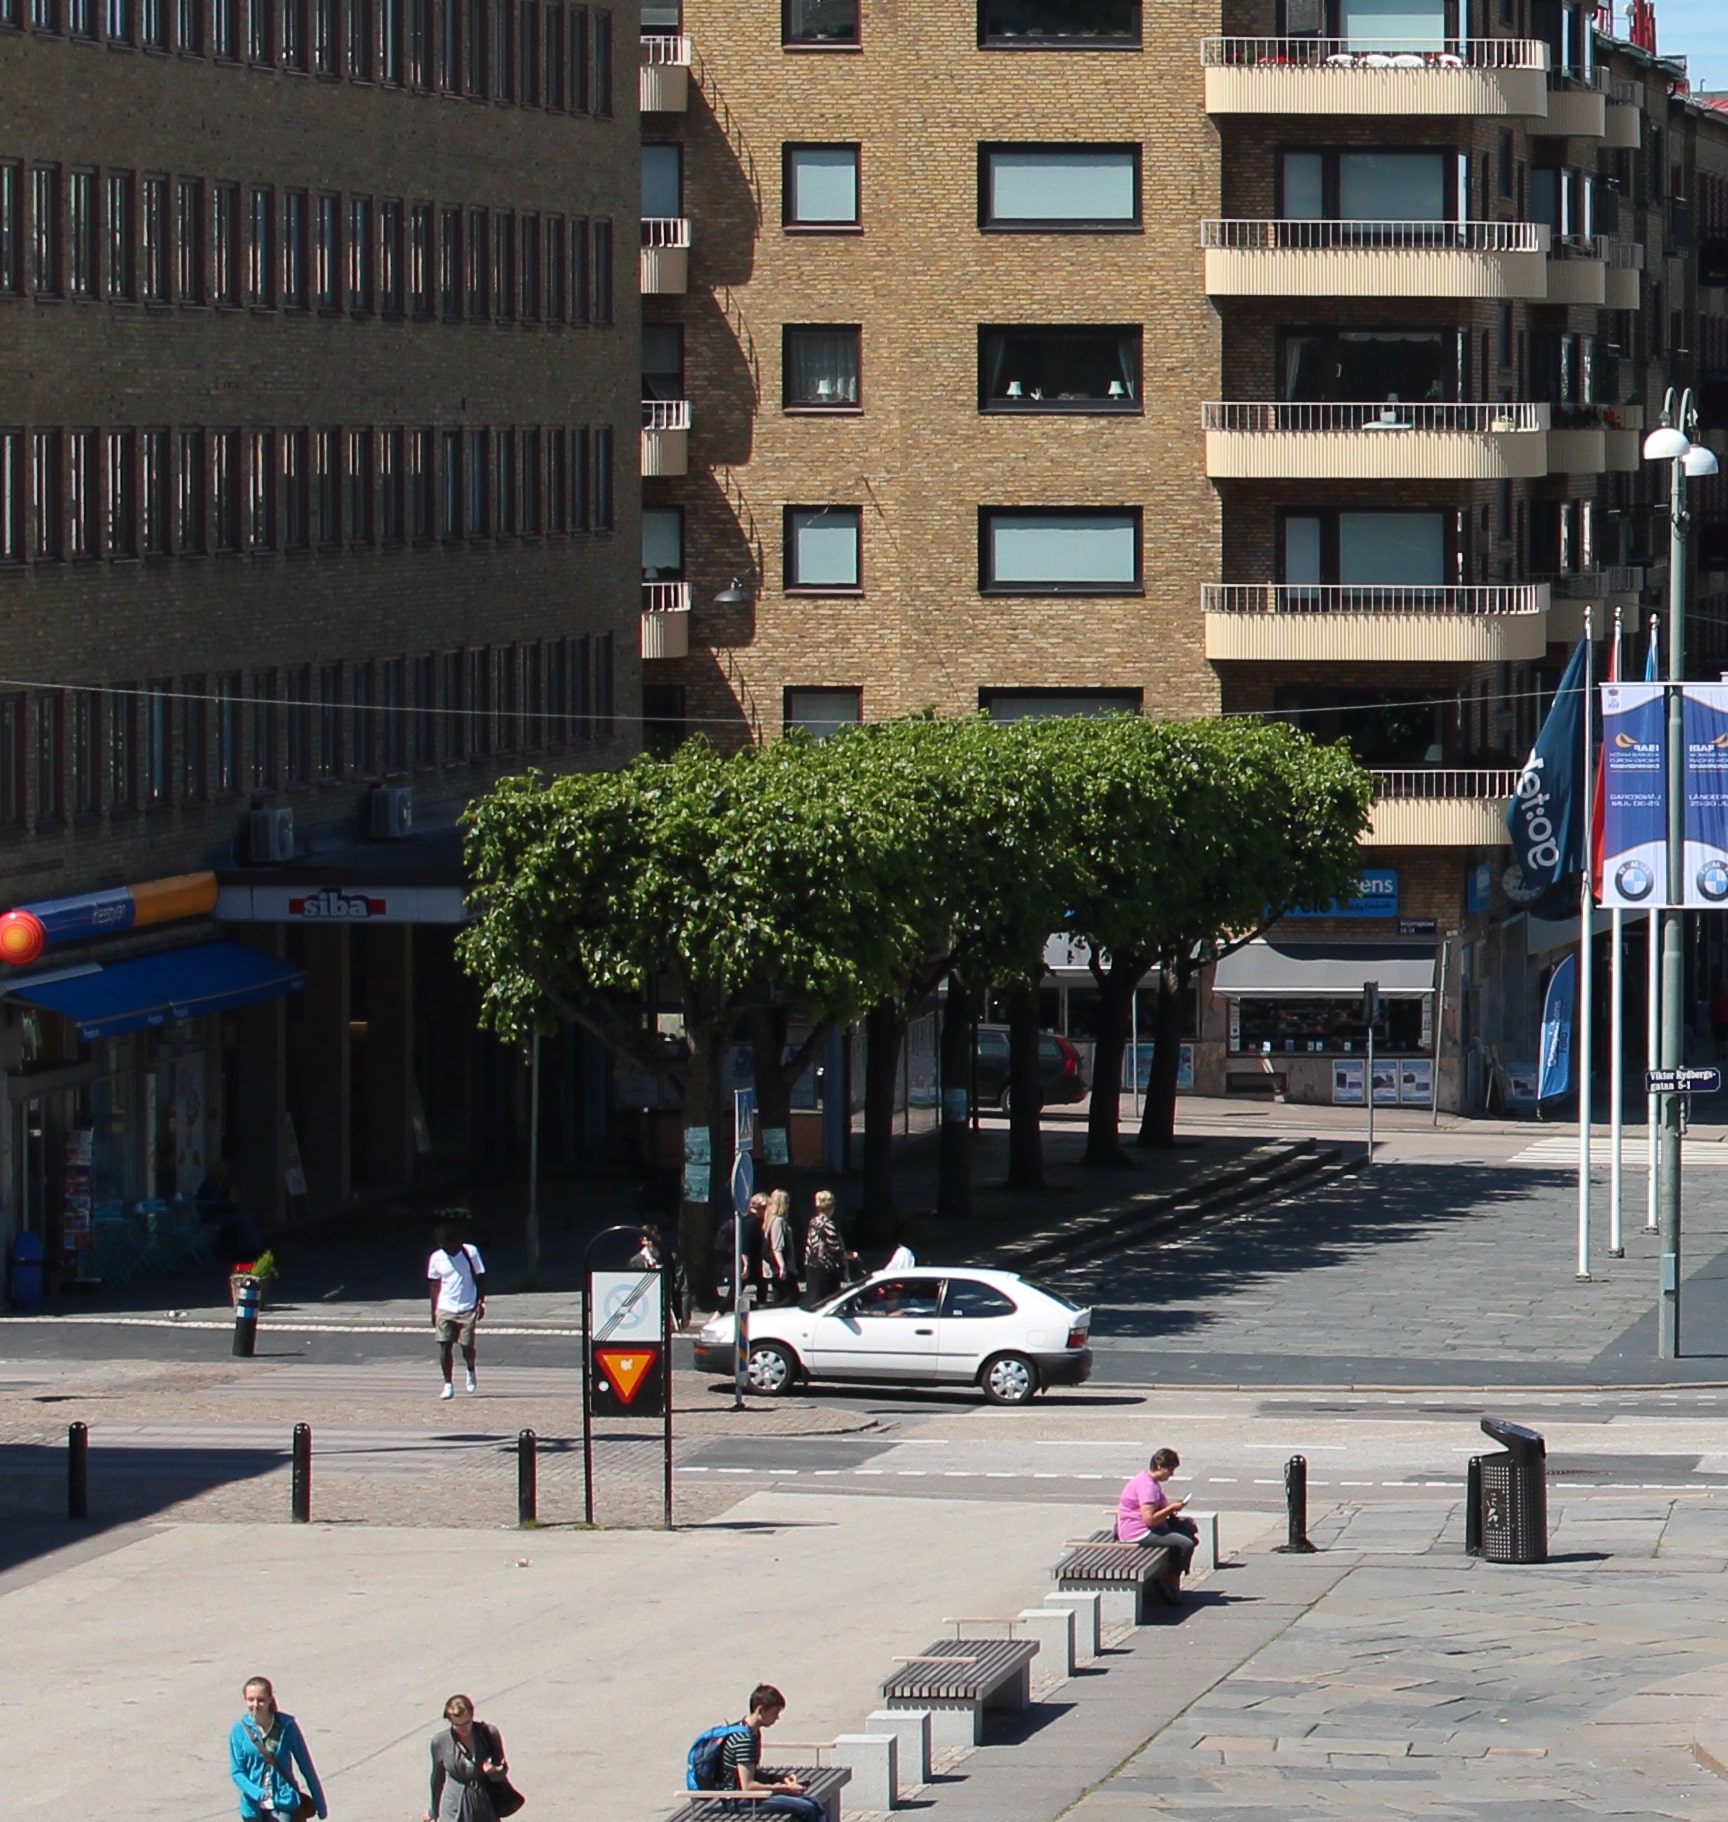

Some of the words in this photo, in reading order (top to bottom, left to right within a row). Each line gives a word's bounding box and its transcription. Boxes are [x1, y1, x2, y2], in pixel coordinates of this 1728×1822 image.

[302, 892, 369, 918] siba
[1650, 1071, 1674, 1080] Viktor
[1650, 1082, 1674, 1092] gatan
